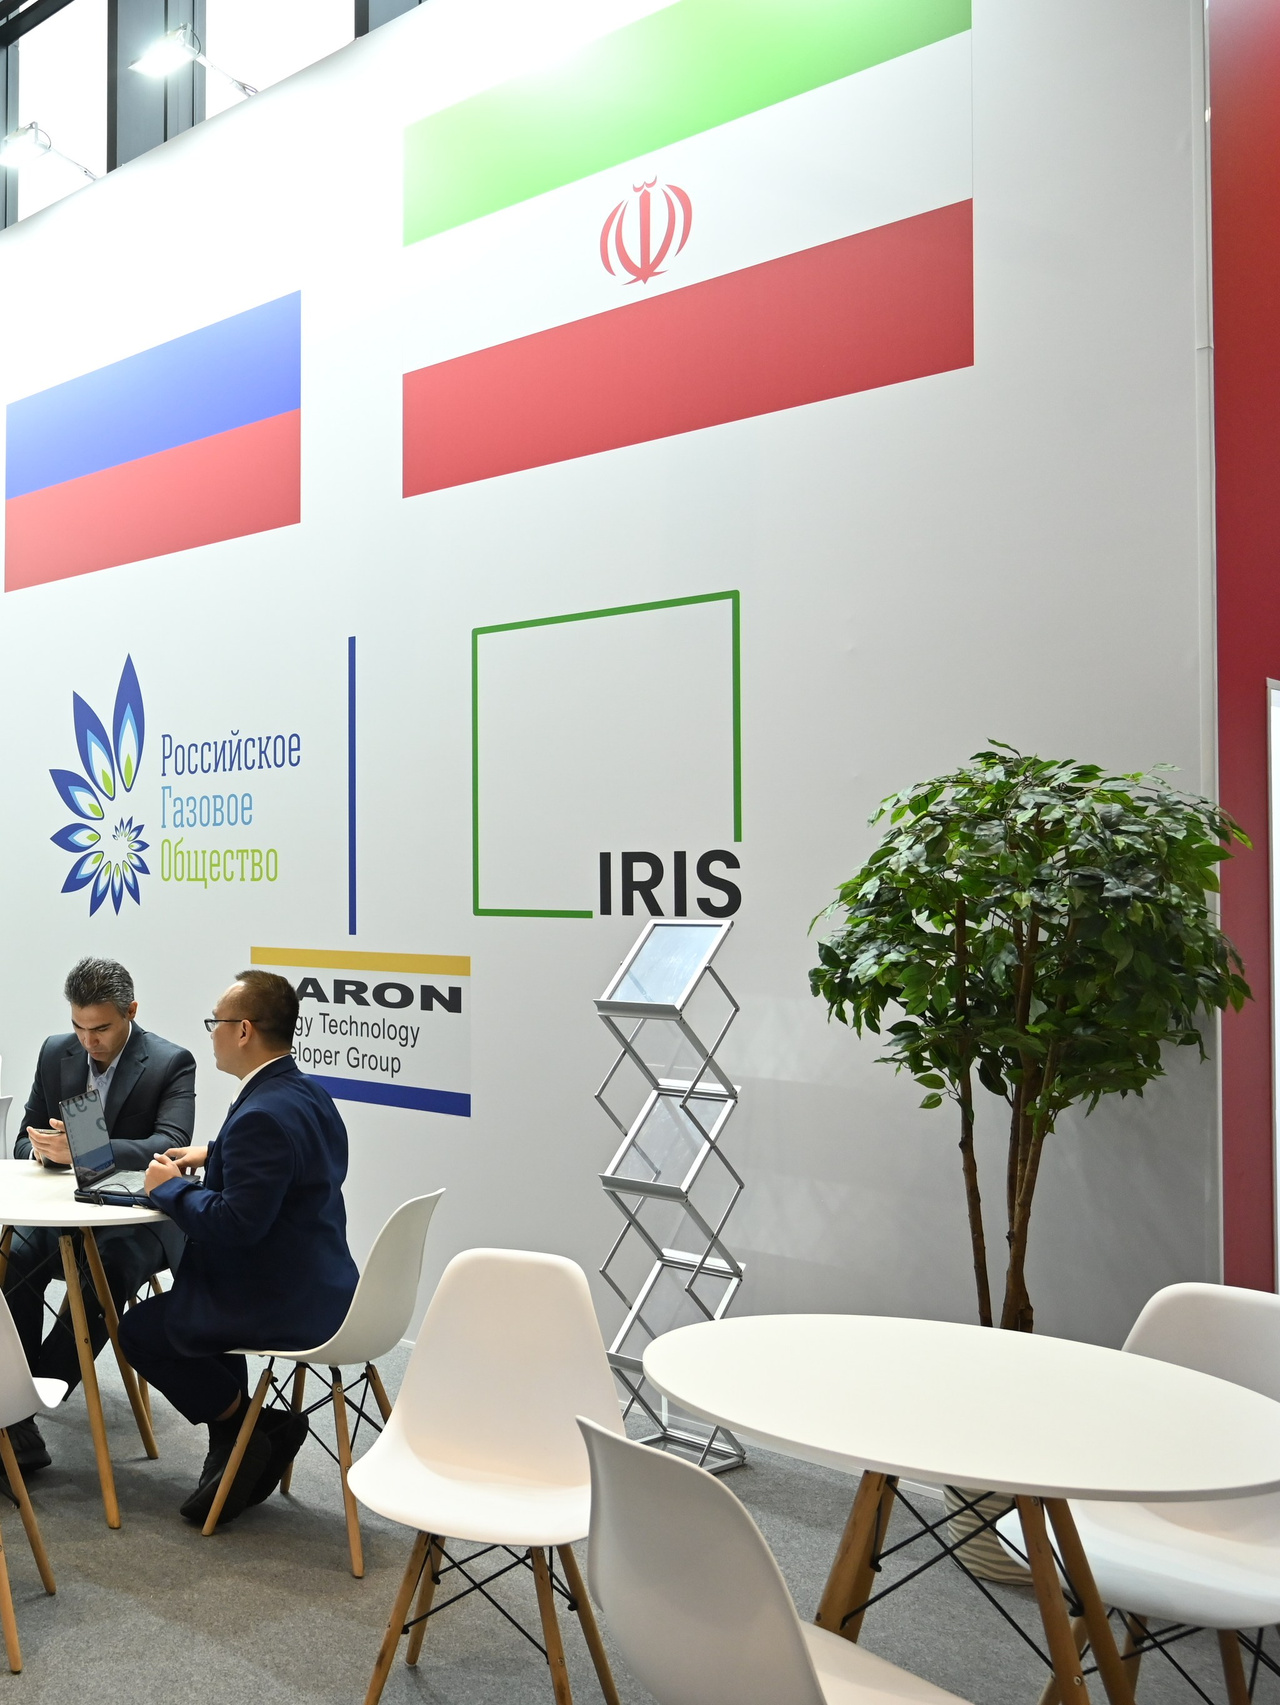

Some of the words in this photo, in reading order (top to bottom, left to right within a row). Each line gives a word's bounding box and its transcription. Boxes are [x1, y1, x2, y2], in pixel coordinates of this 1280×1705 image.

[161, 729, 301, 777] Российское
[161, 785, 253, 829] Газовое
[161, 836, 278, 889] Общество
[599, 849, 742, 918] IRIS
[296, 977, 462, 1014] ARON
[319, 1012, 420, 1048] Technology
[290, 1041, 340, 1069] eloper
[346, 1046, 401, 1078] Group
